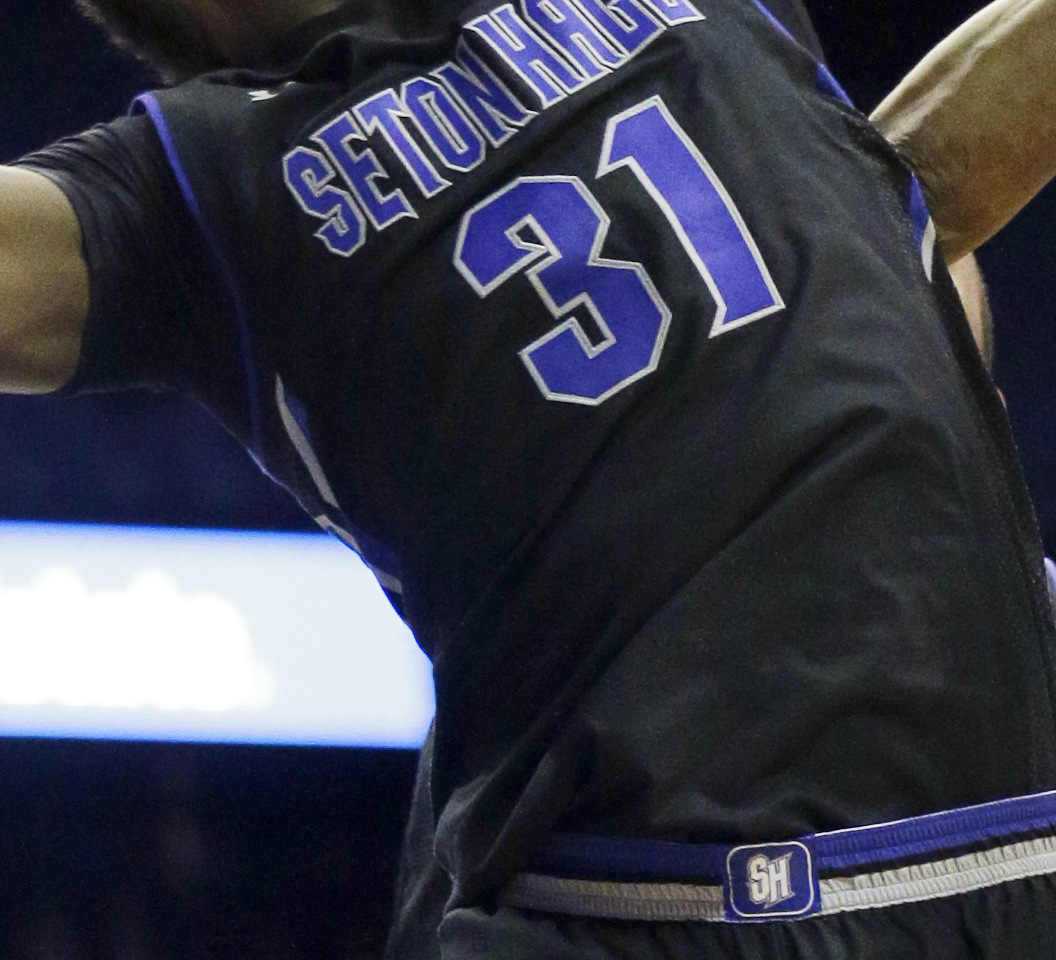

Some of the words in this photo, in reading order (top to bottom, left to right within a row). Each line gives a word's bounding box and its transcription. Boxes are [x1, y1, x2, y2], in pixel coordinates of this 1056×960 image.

[282, 60, 540, 258] SETON
[453, 94, 787, 406] 31
[747, 852, 796, 909] SH
